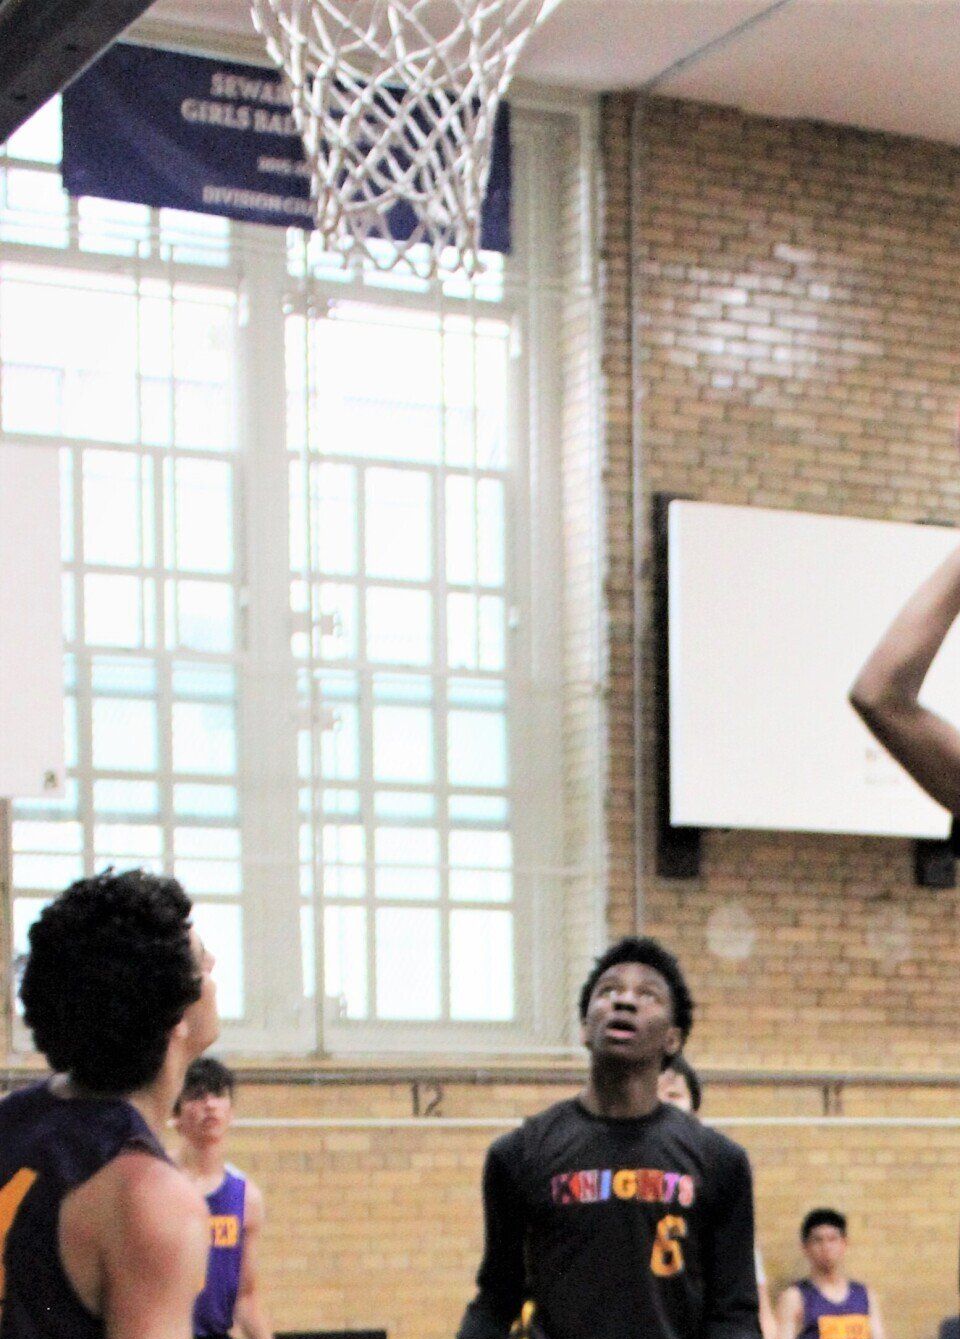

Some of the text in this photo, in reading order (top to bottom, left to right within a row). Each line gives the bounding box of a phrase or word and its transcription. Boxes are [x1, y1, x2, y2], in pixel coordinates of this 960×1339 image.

[181, 98, 251, 131] GIRLS
[411, 1080, 443, 1117] 12
[551, 1168, 695, 1208] KNIGHTS
[650, 1214, 688, 1277] 6
